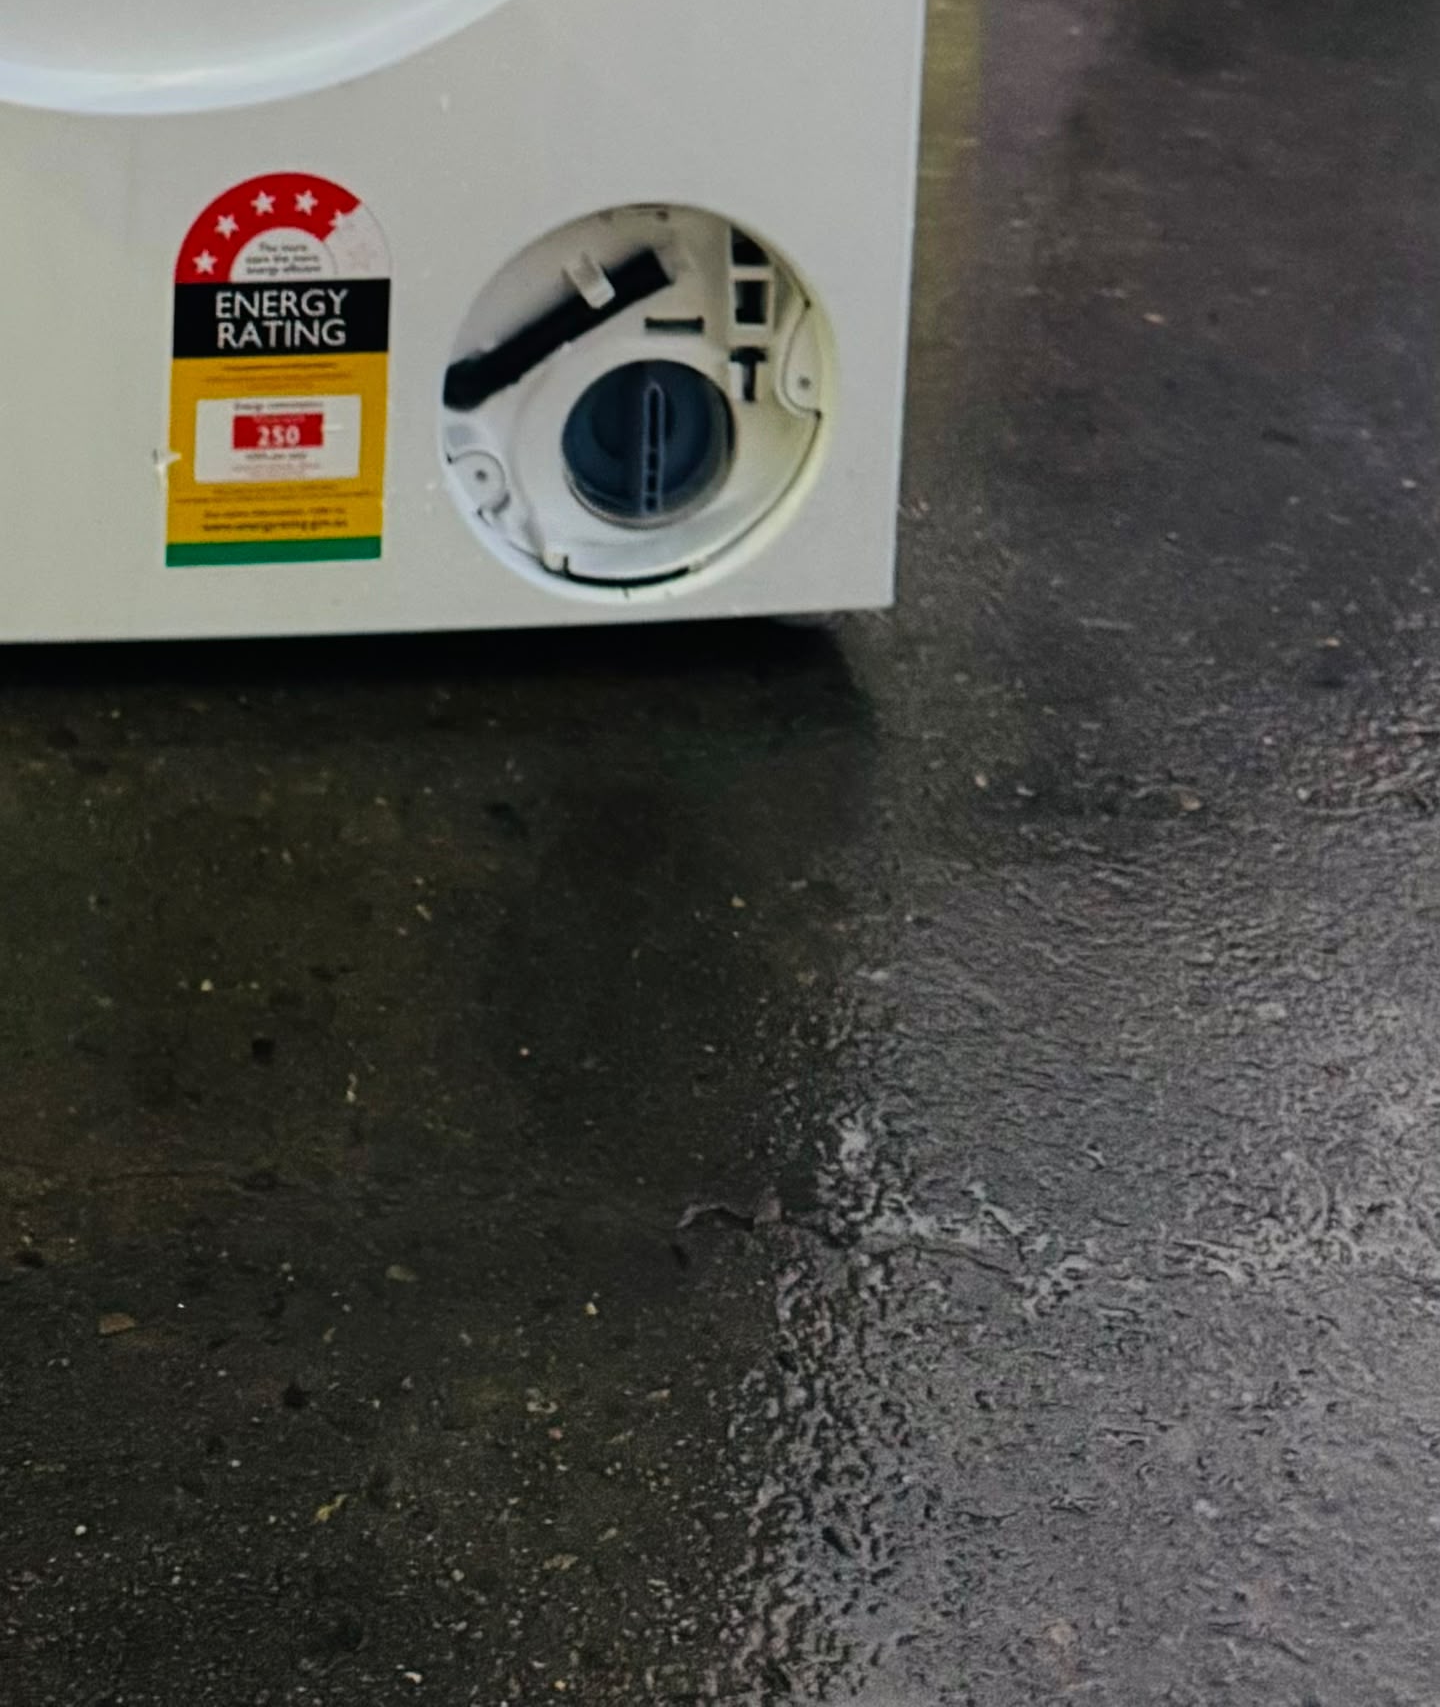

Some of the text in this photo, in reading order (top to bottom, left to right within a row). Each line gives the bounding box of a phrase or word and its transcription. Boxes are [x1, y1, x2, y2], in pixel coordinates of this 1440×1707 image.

[215, 289, 349, 319] ENERGY
[216, 319, 346, 350] RATING
[256, 424, 301, 447] 250
